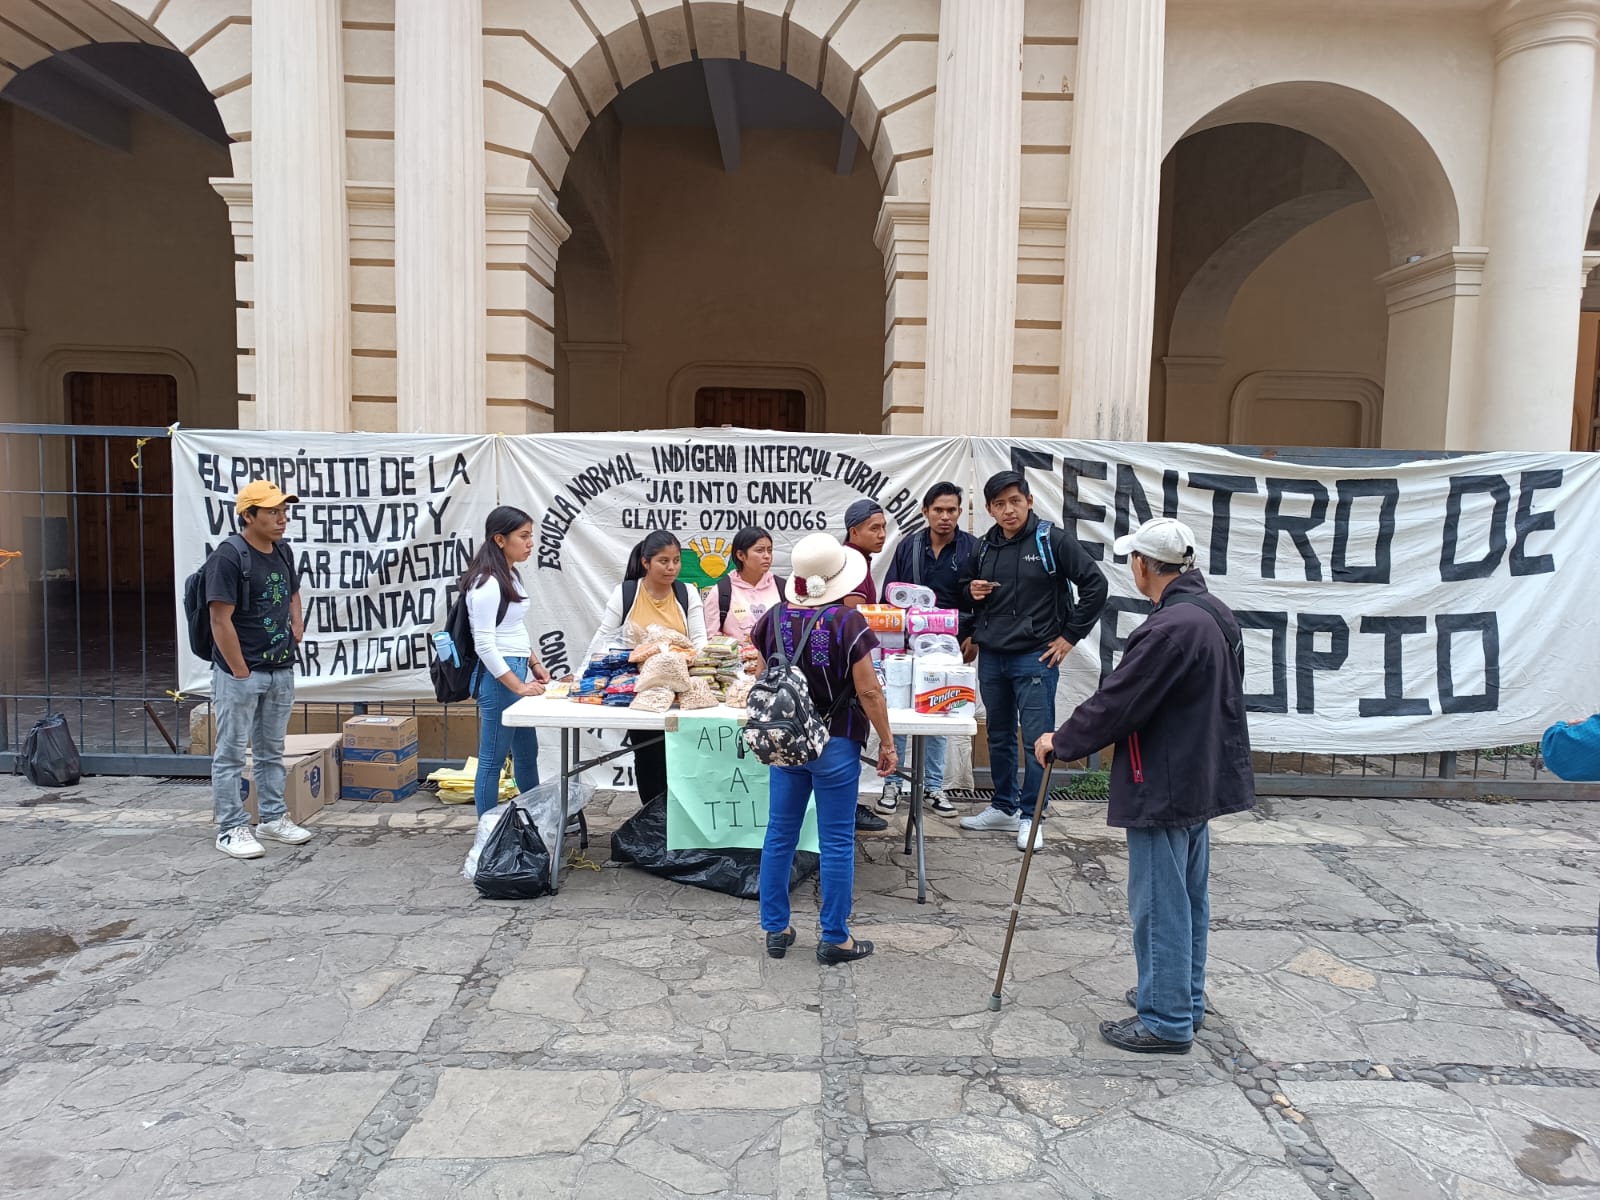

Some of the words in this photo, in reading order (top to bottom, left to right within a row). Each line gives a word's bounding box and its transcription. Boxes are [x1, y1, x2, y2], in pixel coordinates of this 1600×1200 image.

[197, 452, 229, 494] EL
[379, 456, 417, 497] DE
[428, 452, 471, 493] LA
[313, 501, 419, 543] SERVIR
[426, 496, 452, 535] Y
[537, 494, 582, 573] ESCUELA
[565, 452, 643, 507] NORMAL
[651, 439, 738, 474] INDÍGENA
[744, 444, 890, 502] INTERCULTURAL
[621, 508, 688, 531] CLAVE:
[1439, 469, 1564, 582] DE
[339, 532, 475, 589] COMPASIÓN
[927, 689, 961, 708] Tender
[729, 767, 749, 794] A
[704, 800, 768, 831] TIL
